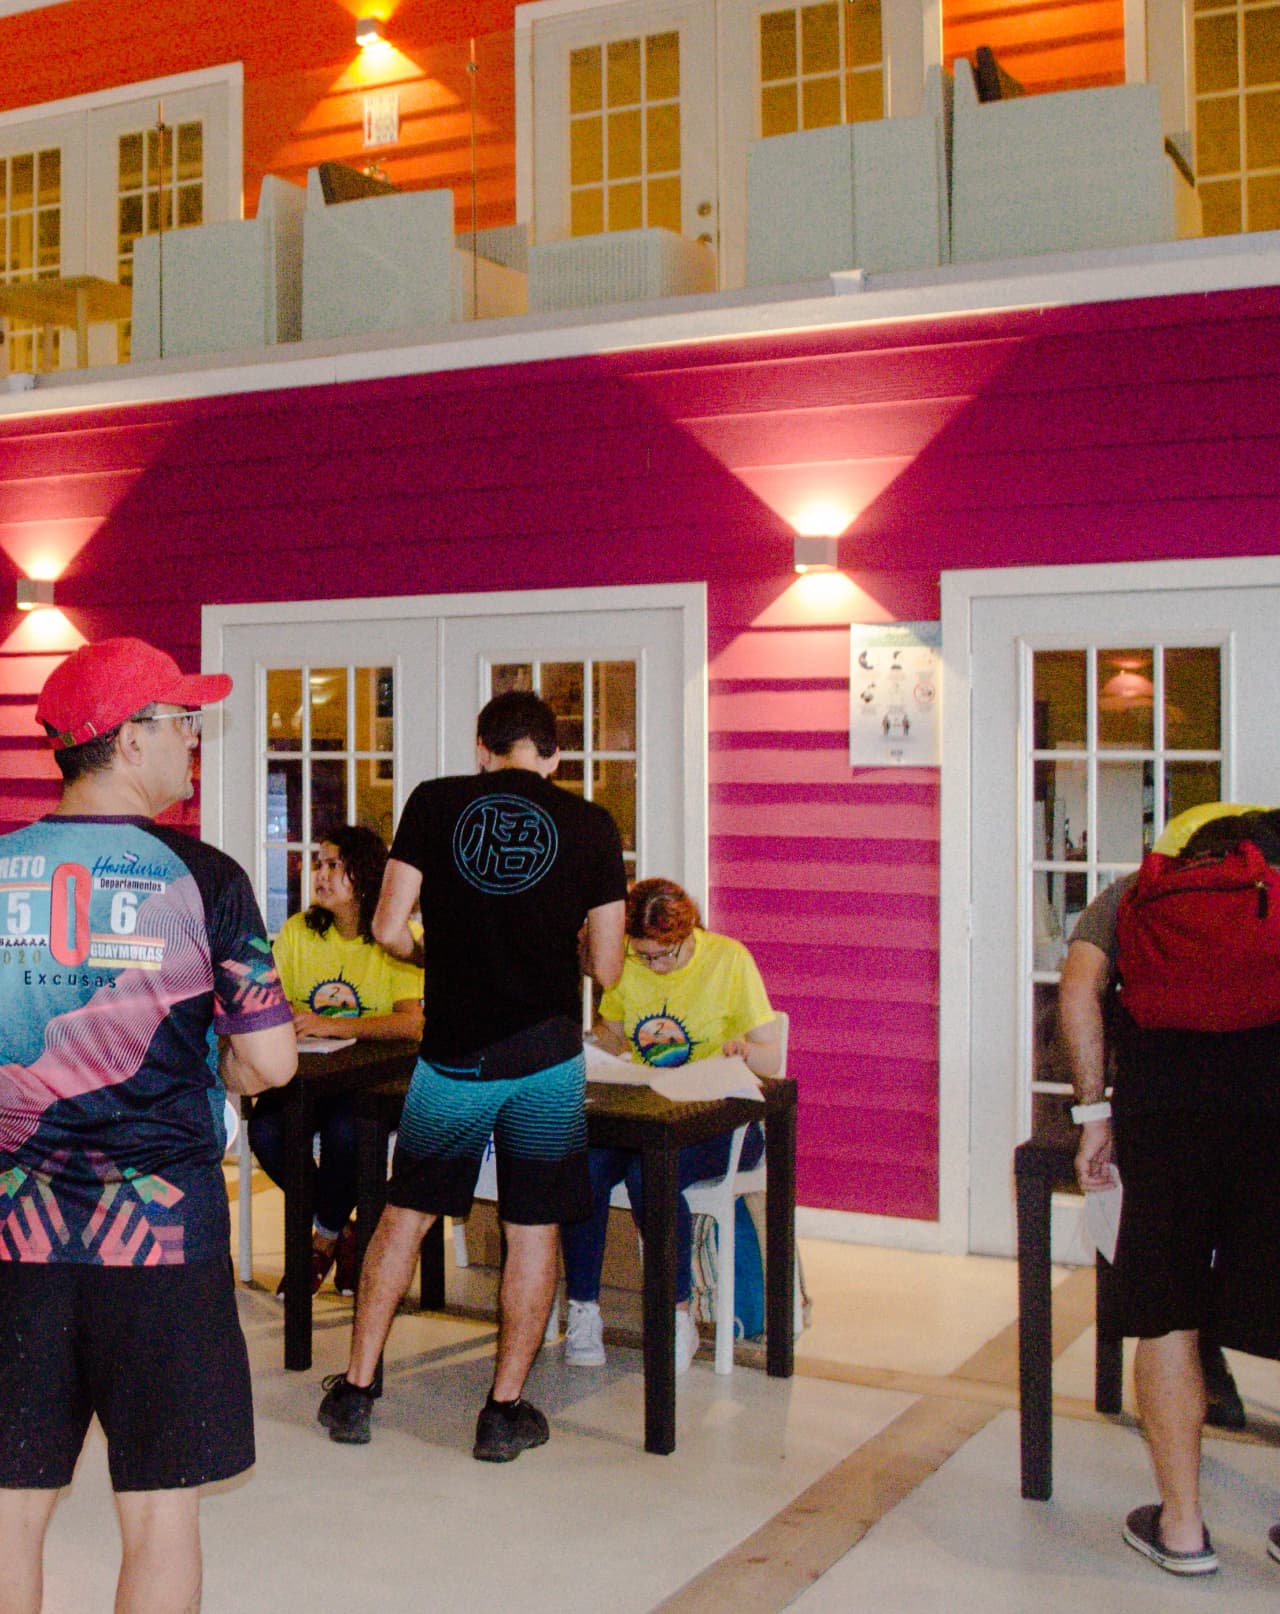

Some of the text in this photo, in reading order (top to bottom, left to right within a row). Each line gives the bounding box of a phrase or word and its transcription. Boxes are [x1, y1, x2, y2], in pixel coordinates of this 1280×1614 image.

[91, 851, 169, 878] Honduras
[100, 878, 162, 891] Departamentos
[90, 943, 164, 962] GUAYMURAS
[24, 970, 117, 989] Excusas
